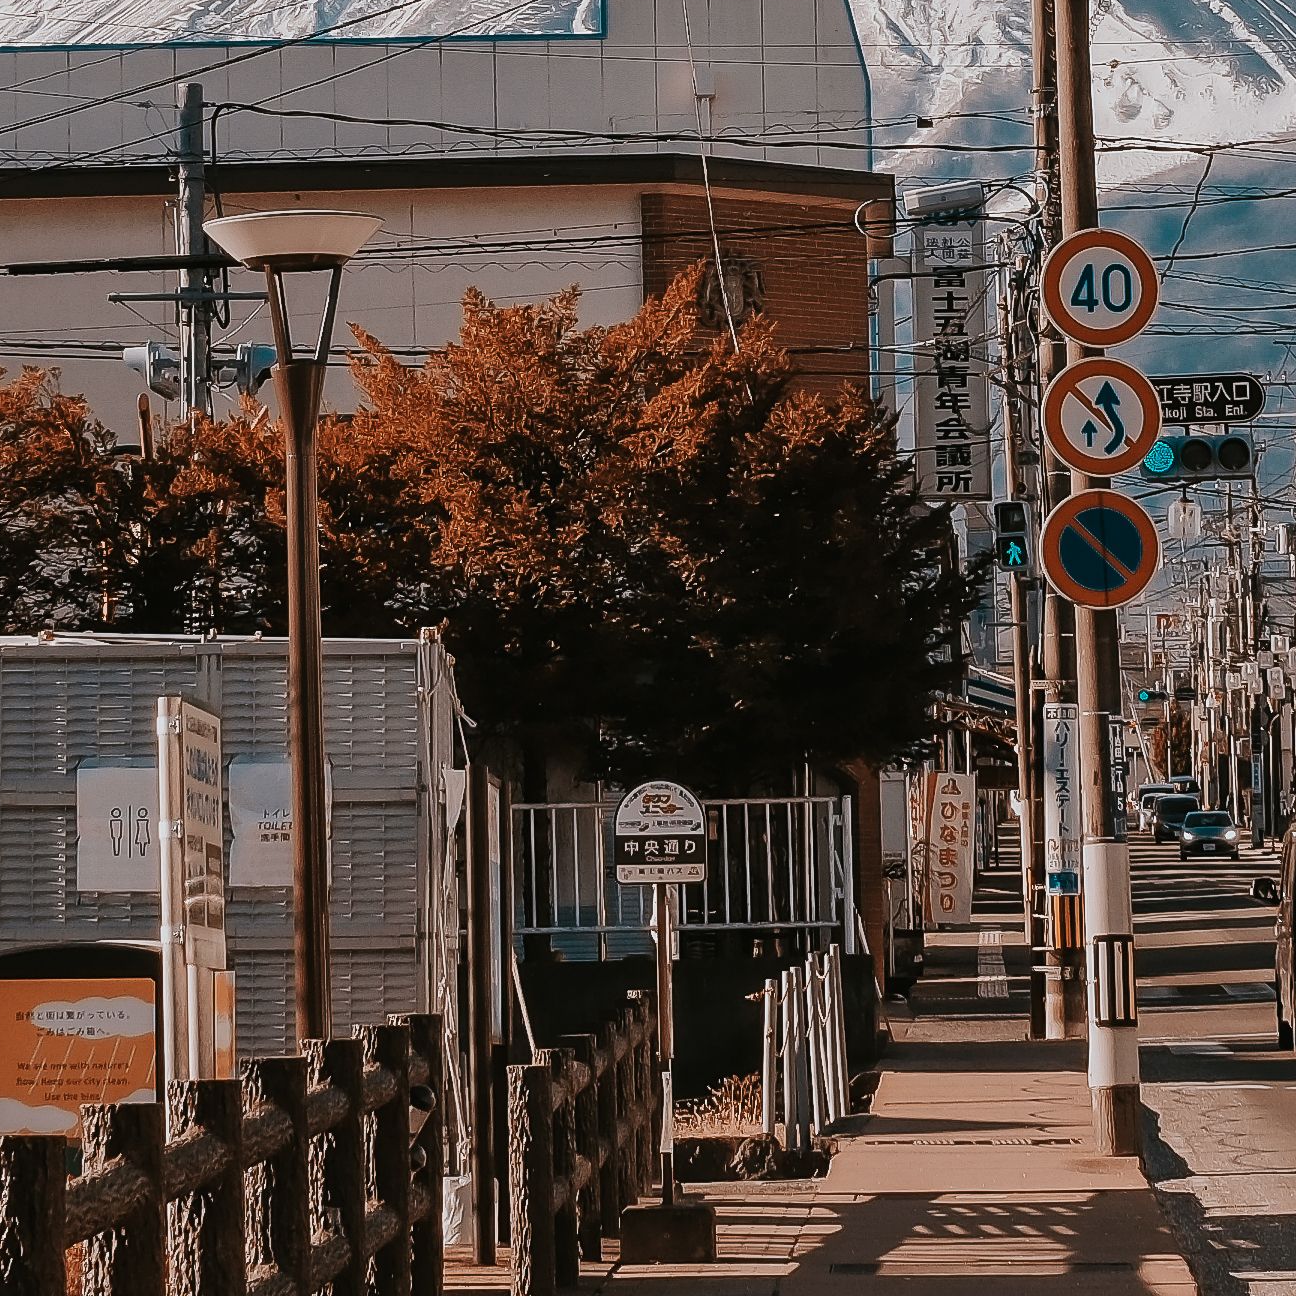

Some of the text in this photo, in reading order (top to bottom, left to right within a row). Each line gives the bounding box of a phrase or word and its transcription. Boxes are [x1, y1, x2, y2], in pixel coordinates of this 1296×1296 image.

[1069, 263, 1133, 314] 40
[932, 265, 972, 492] 富士五湖青年会議所
[264, 809, 290, 818] トイレ
[624, 840, 696, 856] 中央通り
[939, 801, 959, 913] ひなまつり
